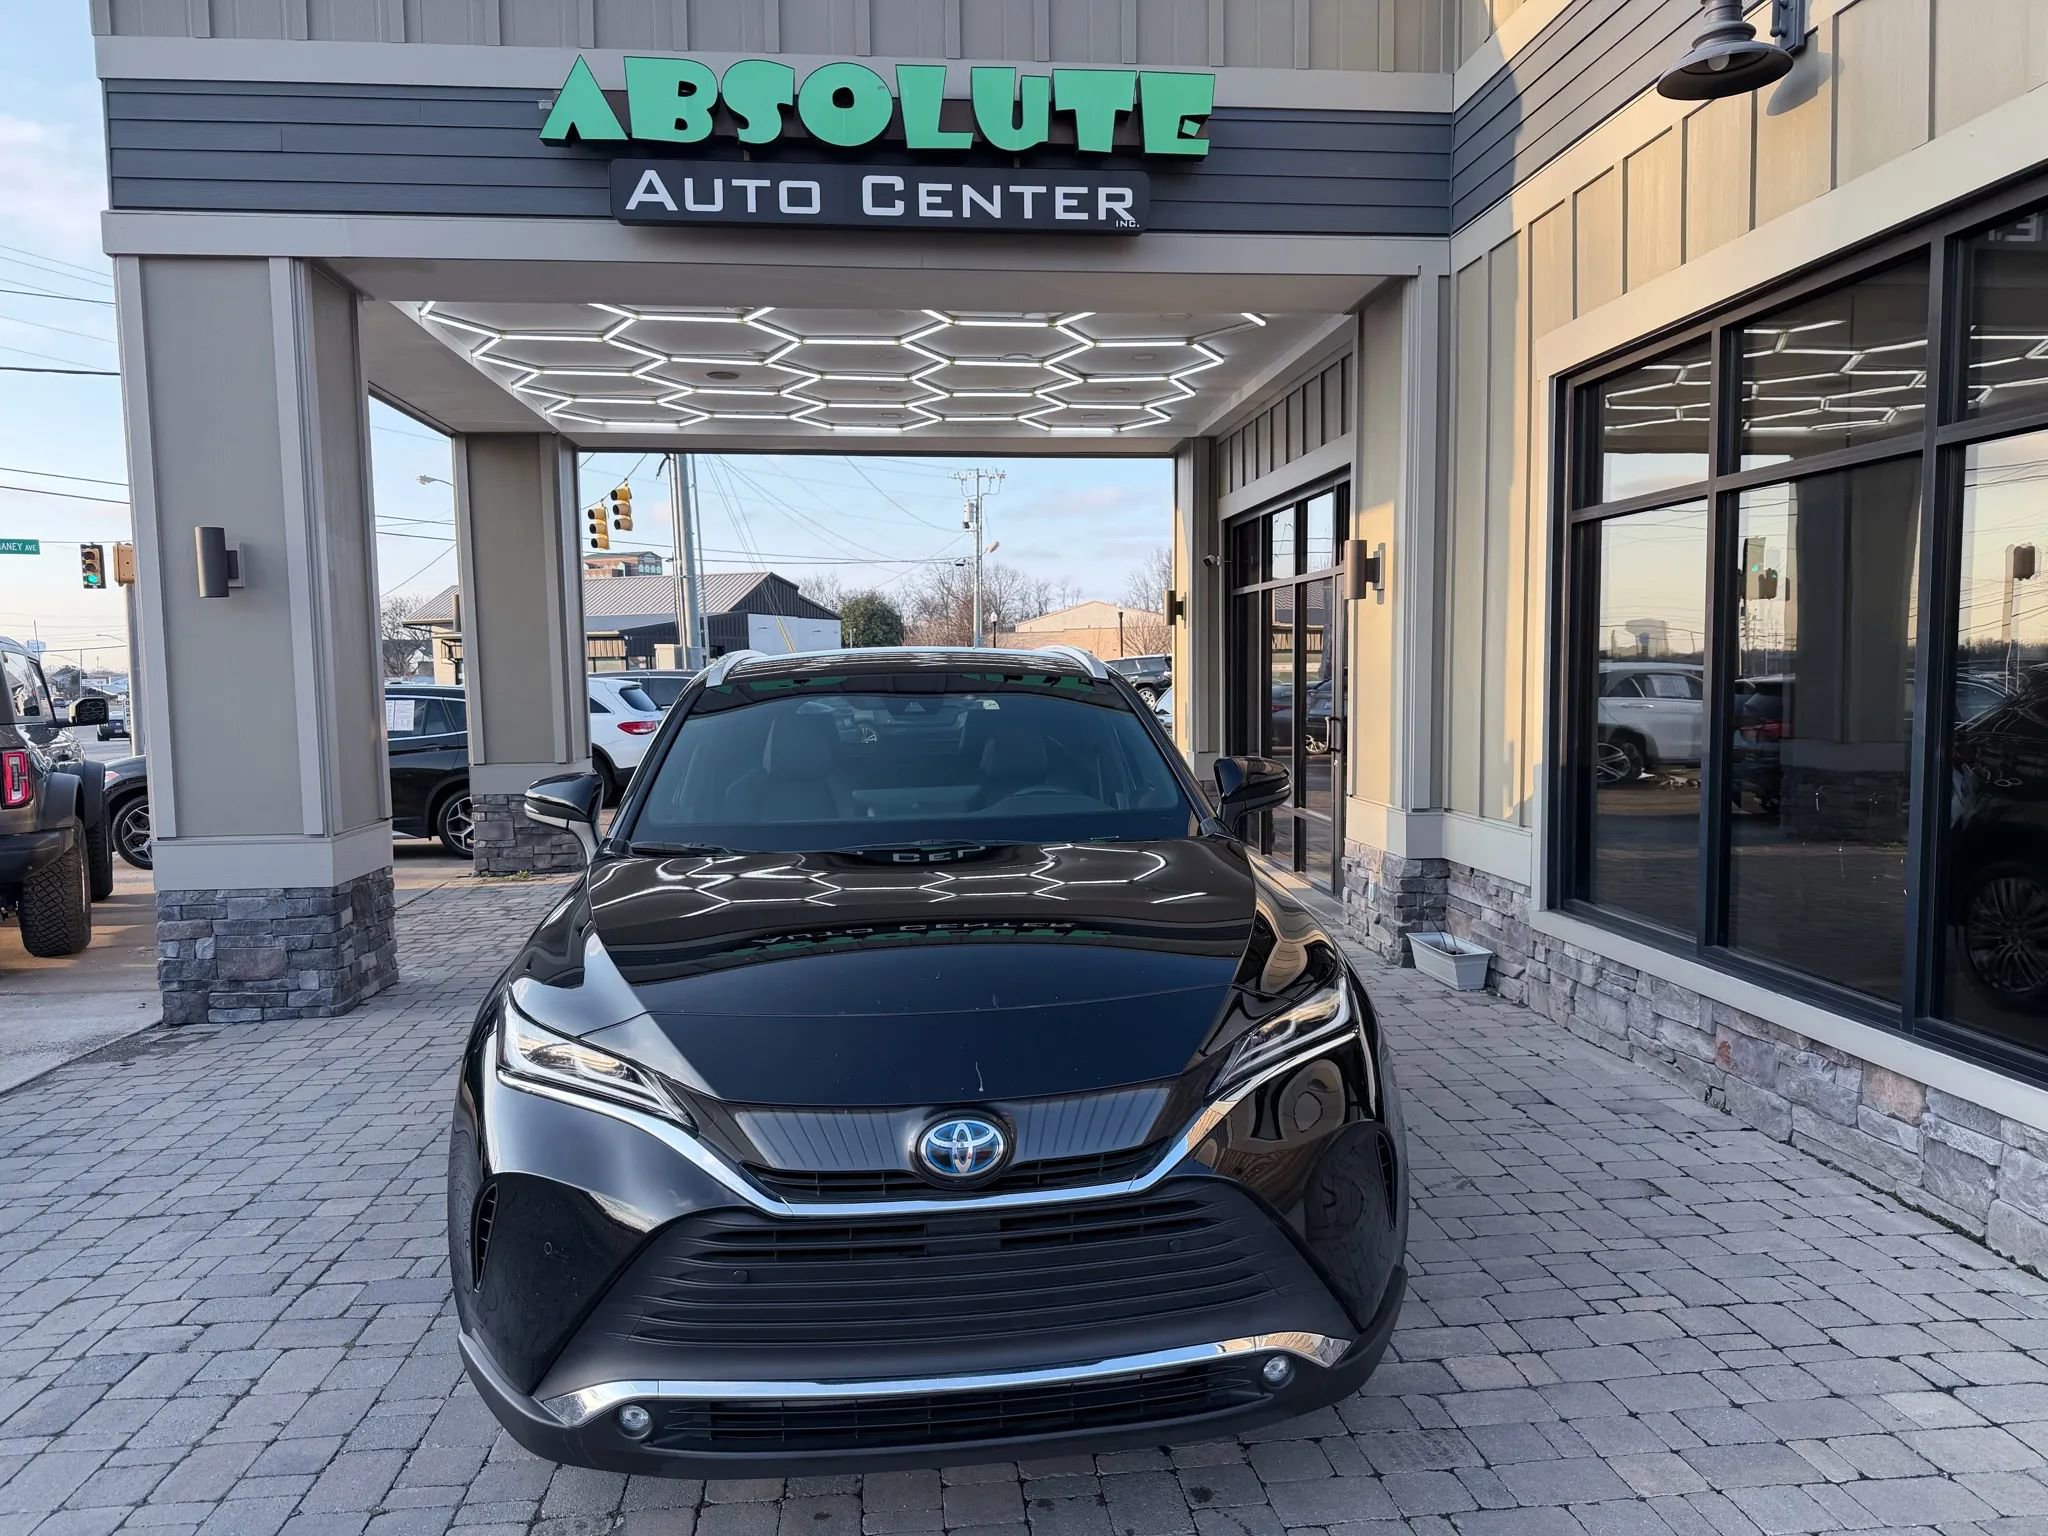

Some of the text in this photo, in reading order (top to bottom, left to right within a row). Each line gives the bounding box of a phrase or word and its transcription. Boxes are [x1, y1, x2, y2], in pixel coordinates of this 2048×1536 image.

[538, 54, 1215, 155] ABSOLUTE
[625, 169, 1135, 220] AUTO CENTER
[1115, 219, 1140, 228] INC.
[0, 542, 23, 551] ANEY
